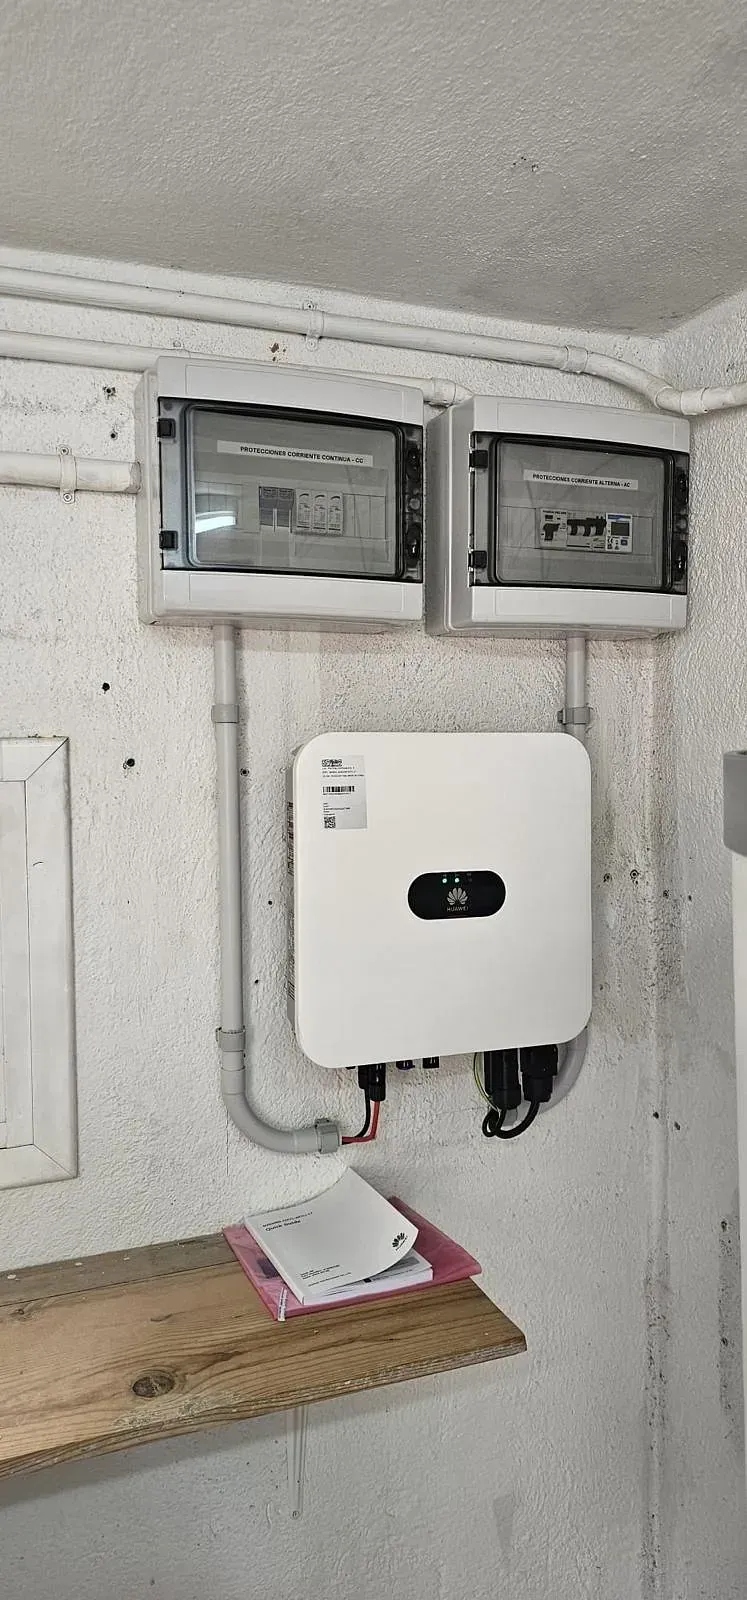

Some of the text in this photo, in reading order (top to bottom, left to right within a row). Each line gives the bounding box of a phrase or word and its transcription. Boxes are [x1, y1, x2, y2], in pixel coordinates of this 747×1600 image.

[240, 446, 286, 456] PROTECCIONES
[287, 452, 321, 460] CORRIENTE
[321, 454, 351, 462] CONTINUA
[533, 474, 570, 482] PROTECCIONES
[571, 477, 598, 485] CORRIENTE
[265, 1224, 282, 1232] Quick
